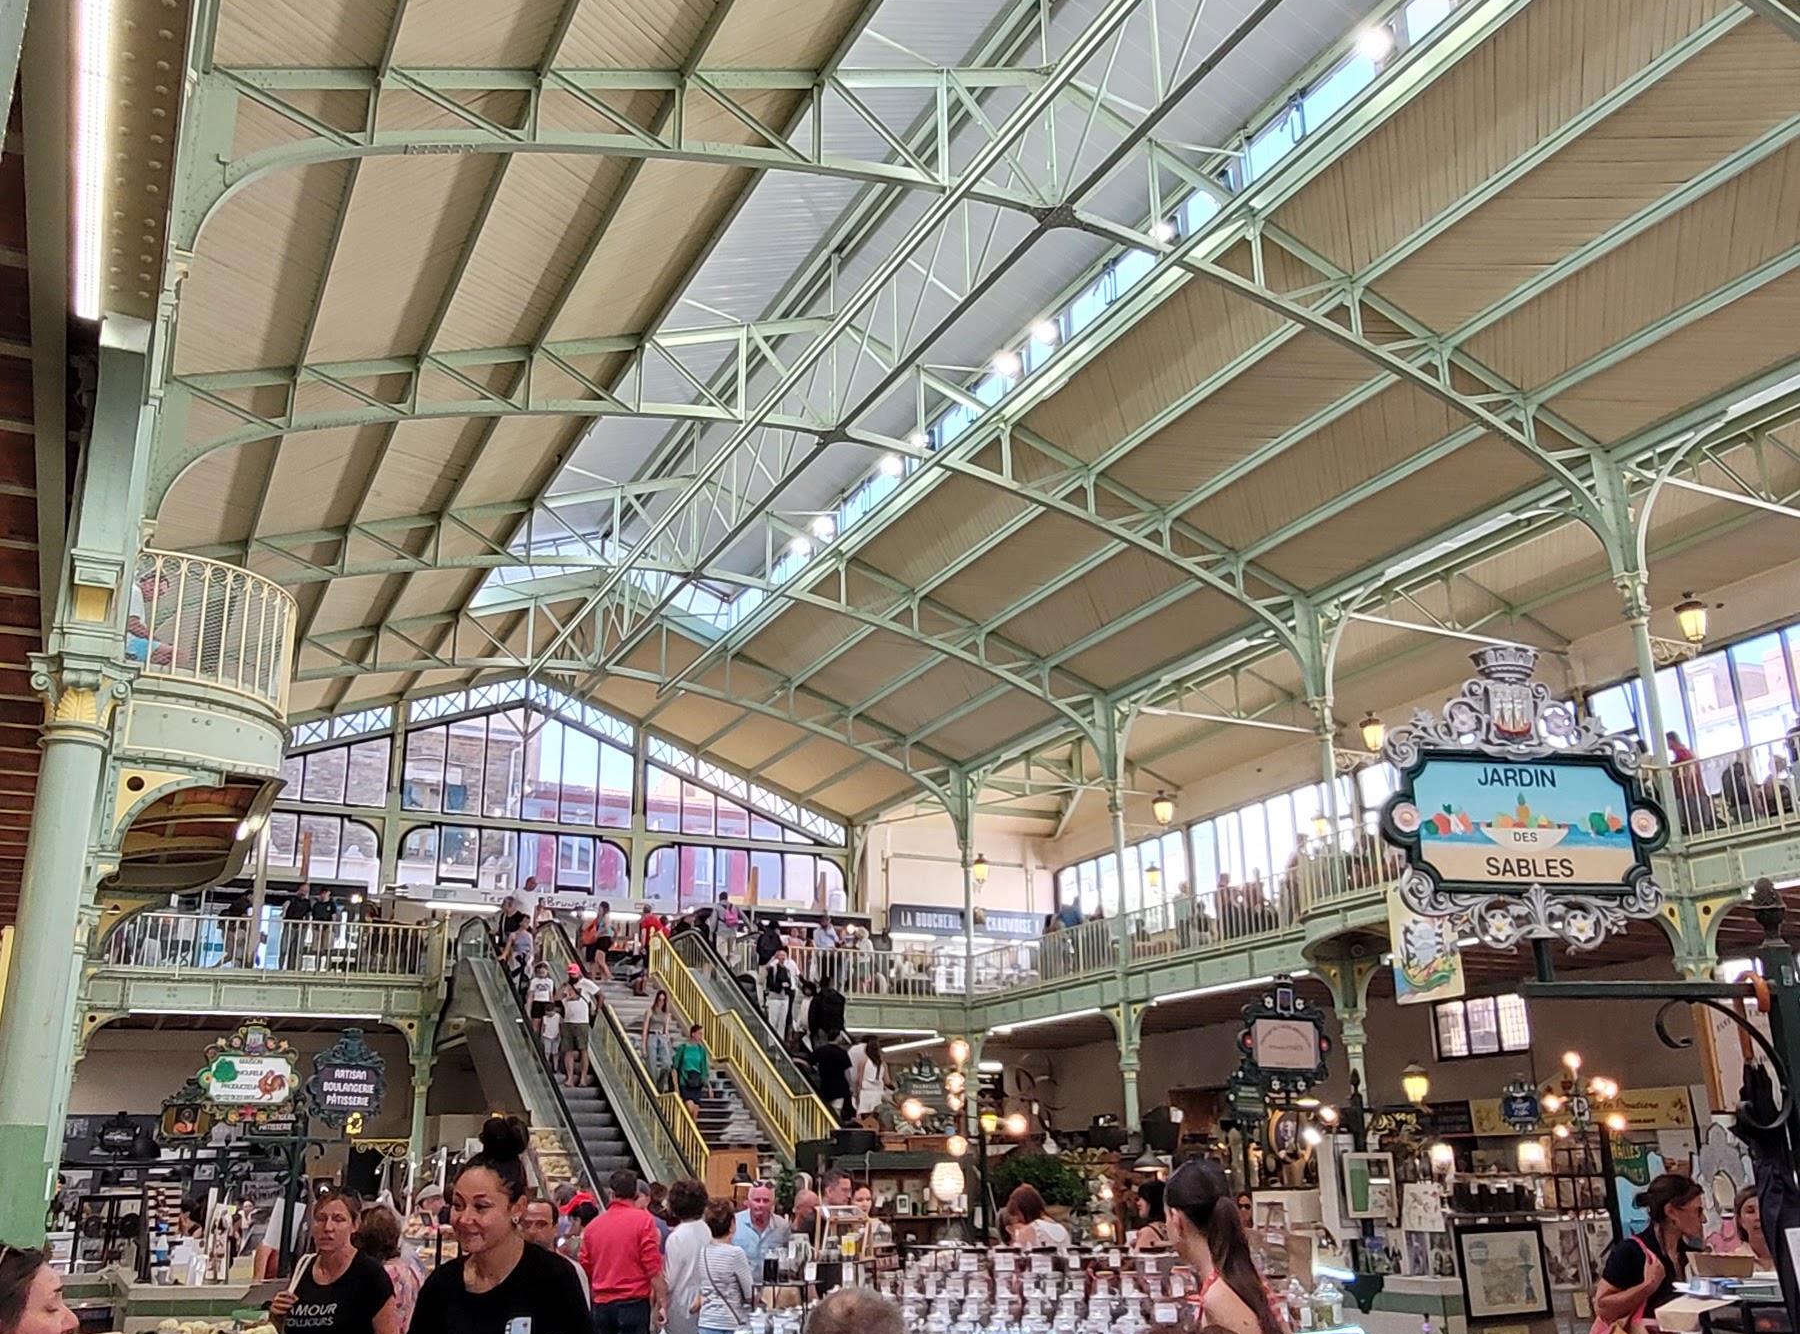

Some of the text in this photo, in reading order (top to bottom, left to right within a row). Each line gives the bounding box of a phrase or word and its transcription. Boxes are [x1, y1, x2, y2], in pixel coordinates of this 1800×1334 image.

[1478, 767, 1556, 787] JARDIN
[1513, 832, 1538, 842] DES
[1486, 857, 1574, 878] SABLES
[901, 910, 912, 927] LA
[915, 912, 962, 930] BOUCHERIE
[334, 1069, 367, 1080] ARTISAN
[323, 1081, 375, 1094] BOULANGERIE
[326, 1093, 369, 1106] PÂTISSERIE
